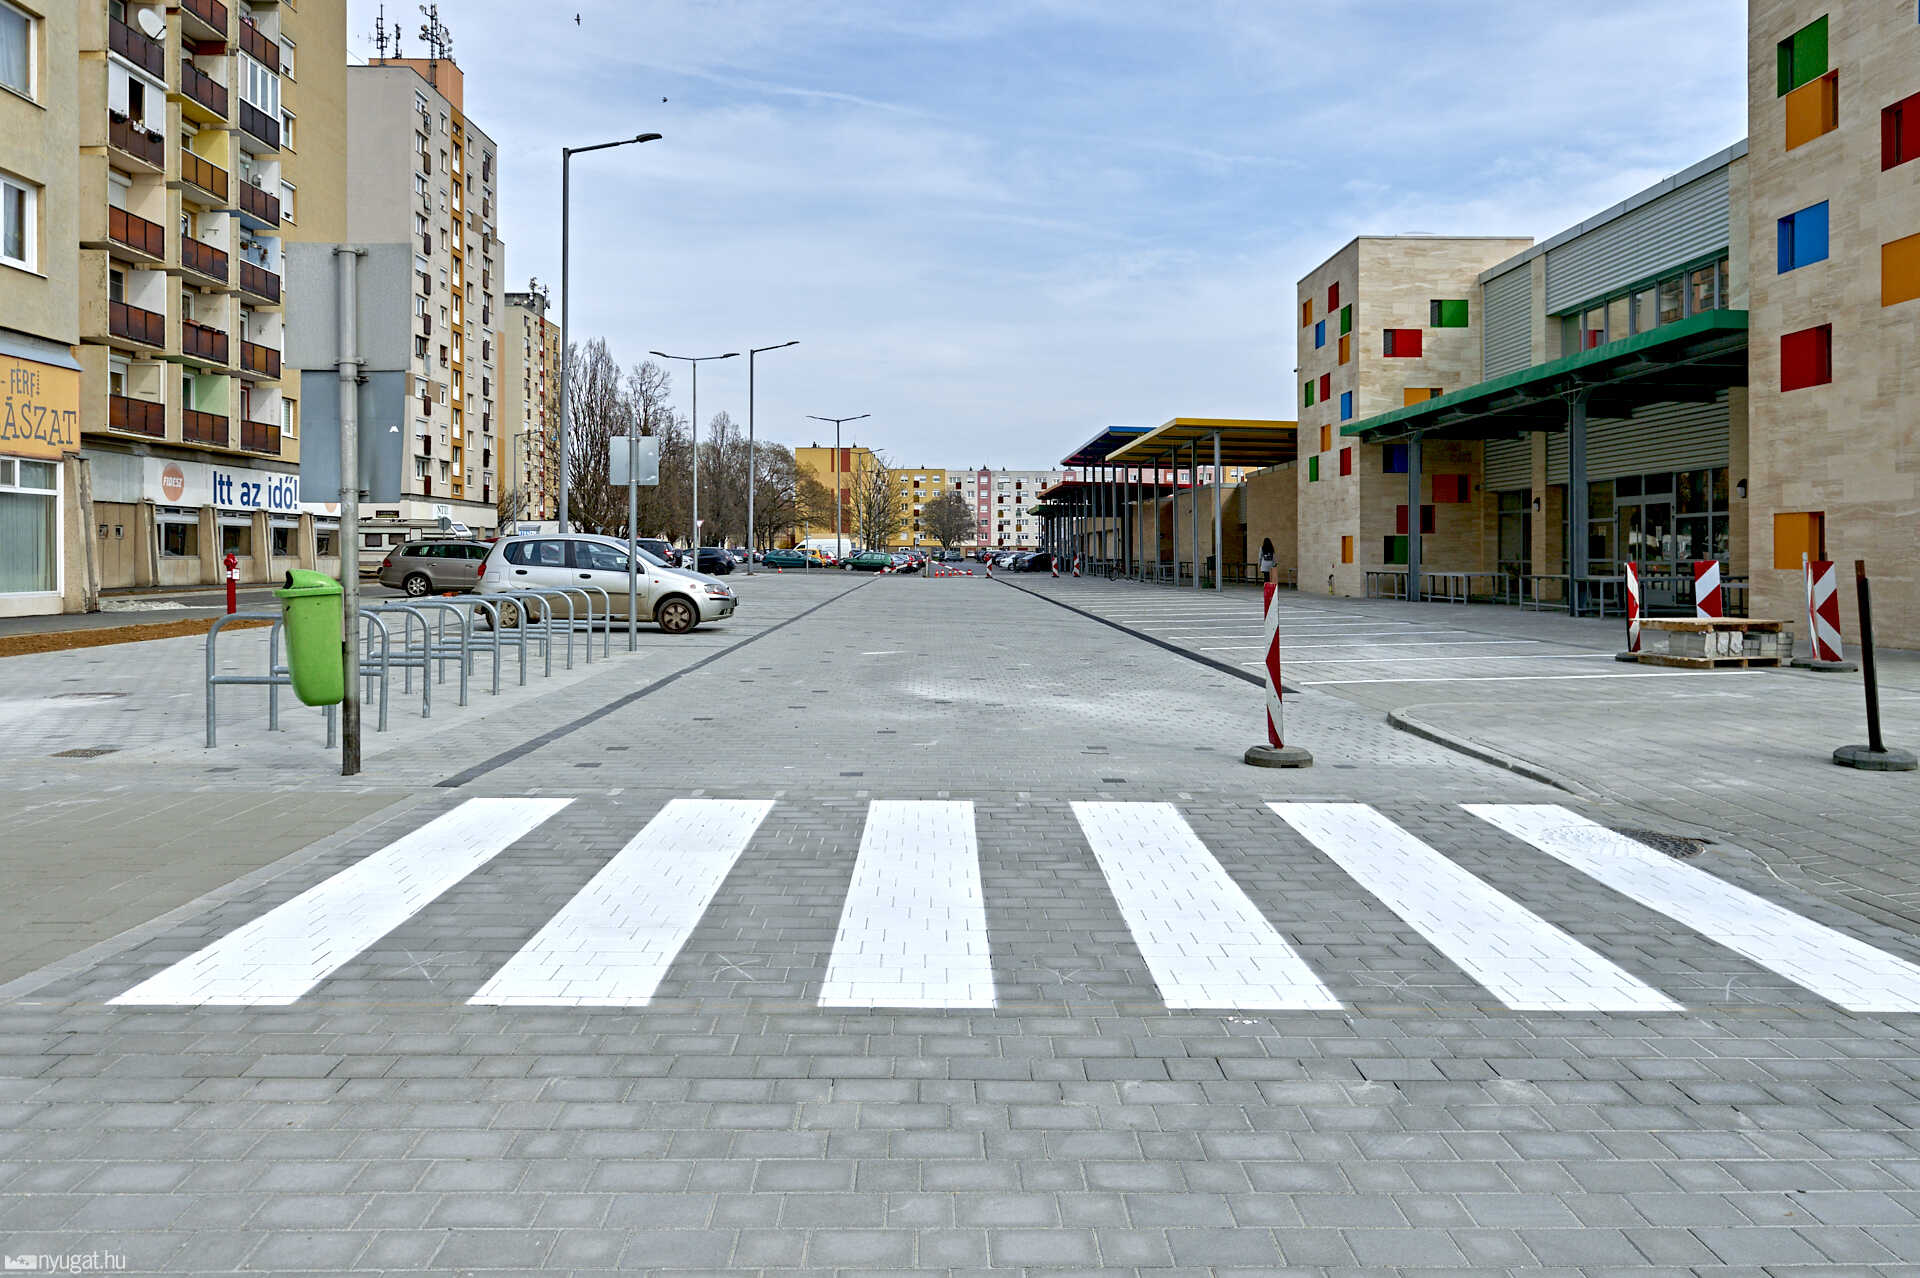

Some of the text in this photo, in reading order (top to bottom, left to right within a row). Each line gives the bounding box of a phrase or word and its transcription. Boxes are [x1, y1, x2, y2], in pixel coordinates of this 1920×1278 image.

[163, 476, 183, 488] FIDESZ
[213, 470, 298, 510] Itt az idő!
